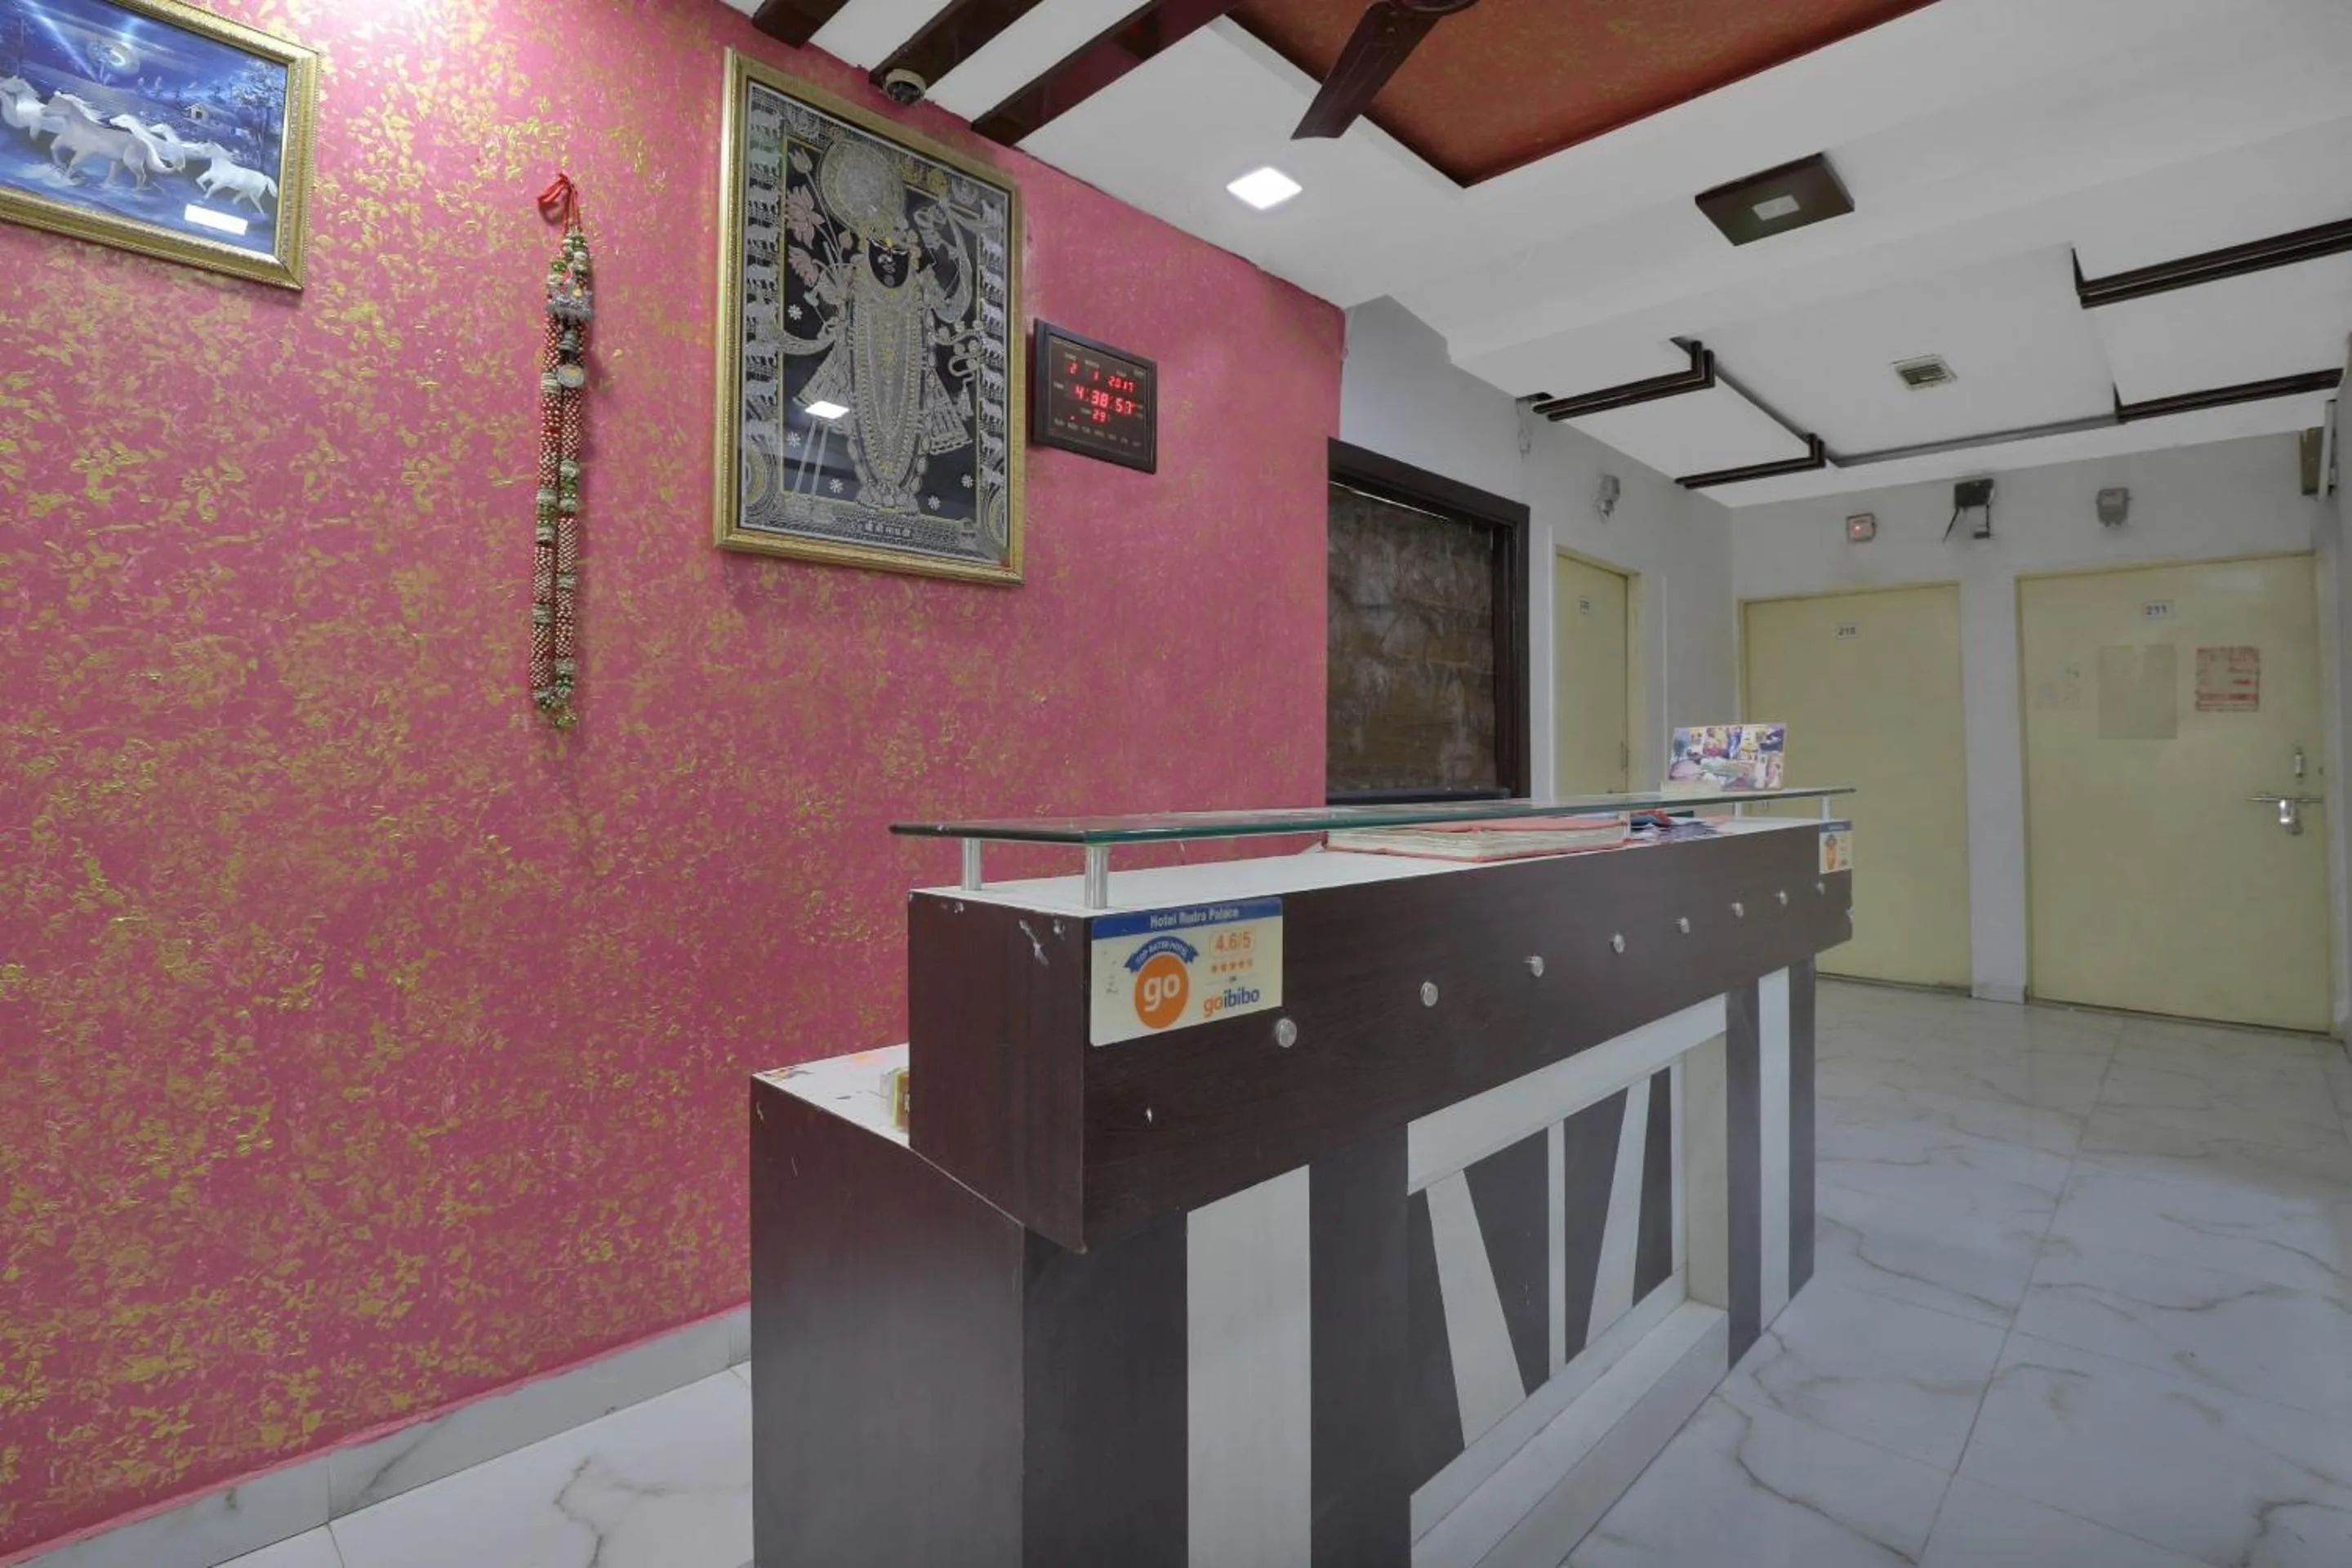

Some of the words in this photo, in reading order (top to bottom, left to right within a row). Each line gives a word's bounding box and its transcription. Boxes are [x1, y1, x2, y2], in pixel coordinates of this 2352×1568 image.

[1150, 912, 1177, 929] Hotel
[1215, 931, 1252, 952] 4.6/5
[1144, 973, 1181, 1012] go
[1203, 987, 1260, 1018] goibibo
